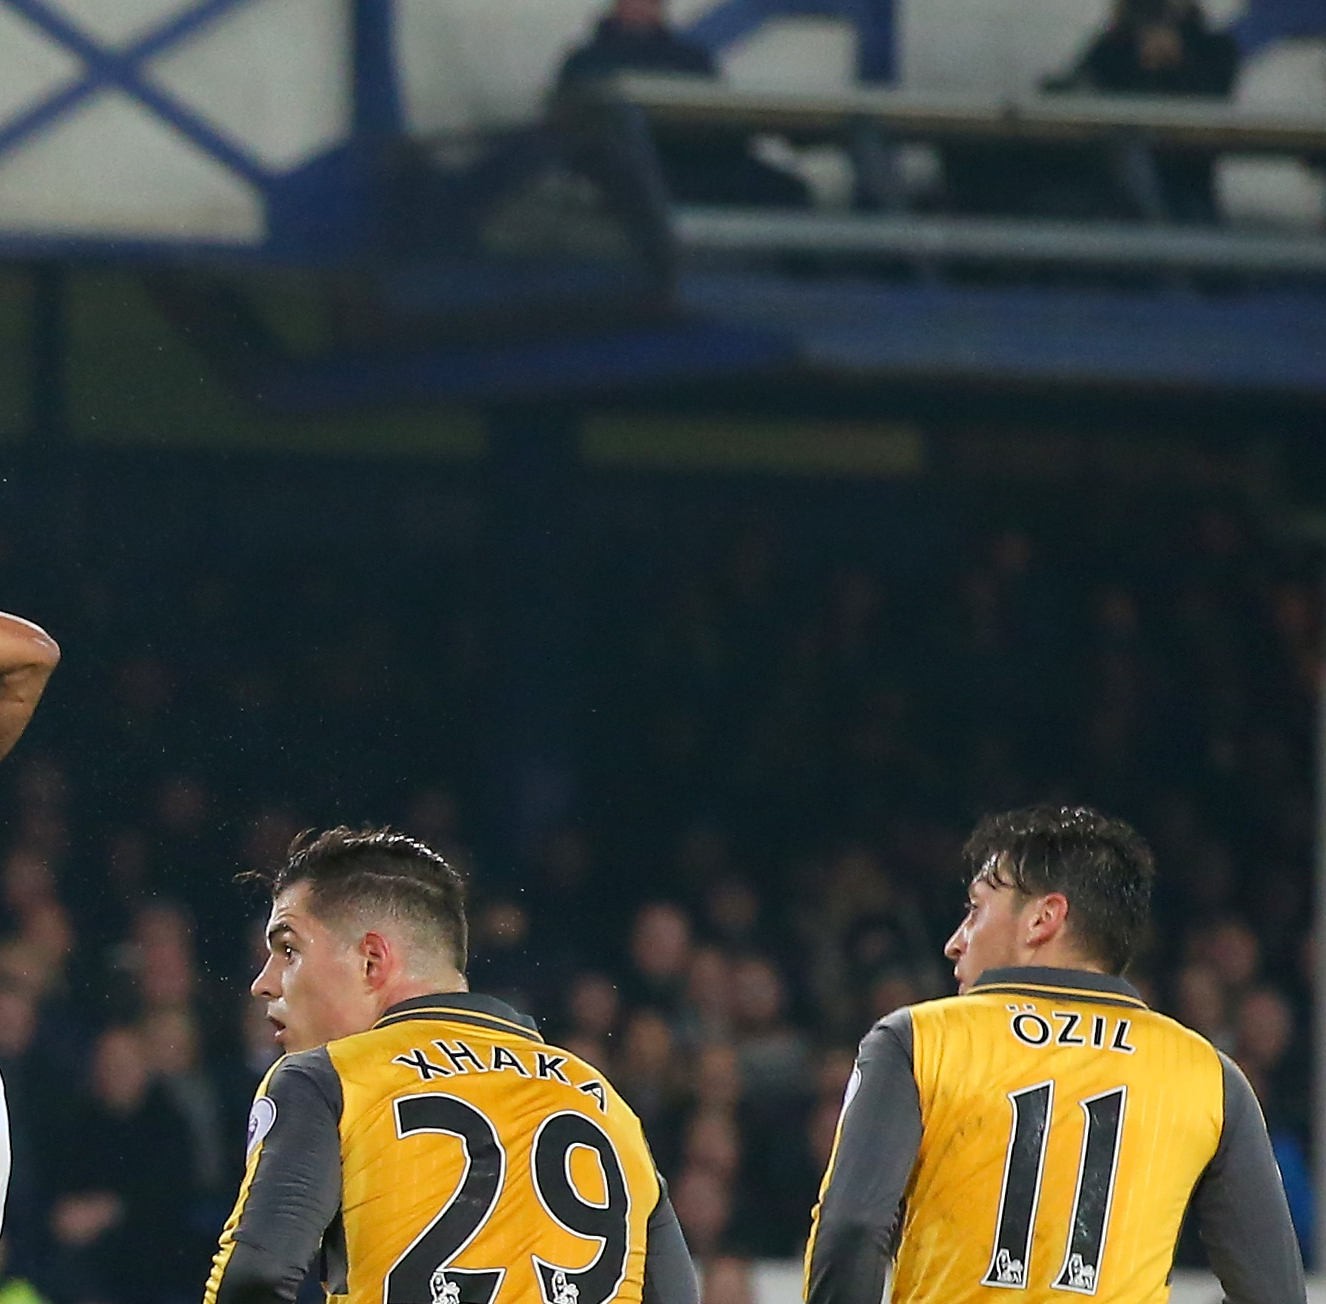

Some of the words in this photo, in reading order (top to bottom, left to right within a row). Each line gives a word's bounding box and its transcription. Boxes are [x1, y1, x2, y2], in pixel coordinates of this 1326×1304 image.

[1005, 1003, 1137, 1054] ÖZIL
[392, 1039, 609, 1115] XHAKA
[980, 1080, 1127, 1296] 11
